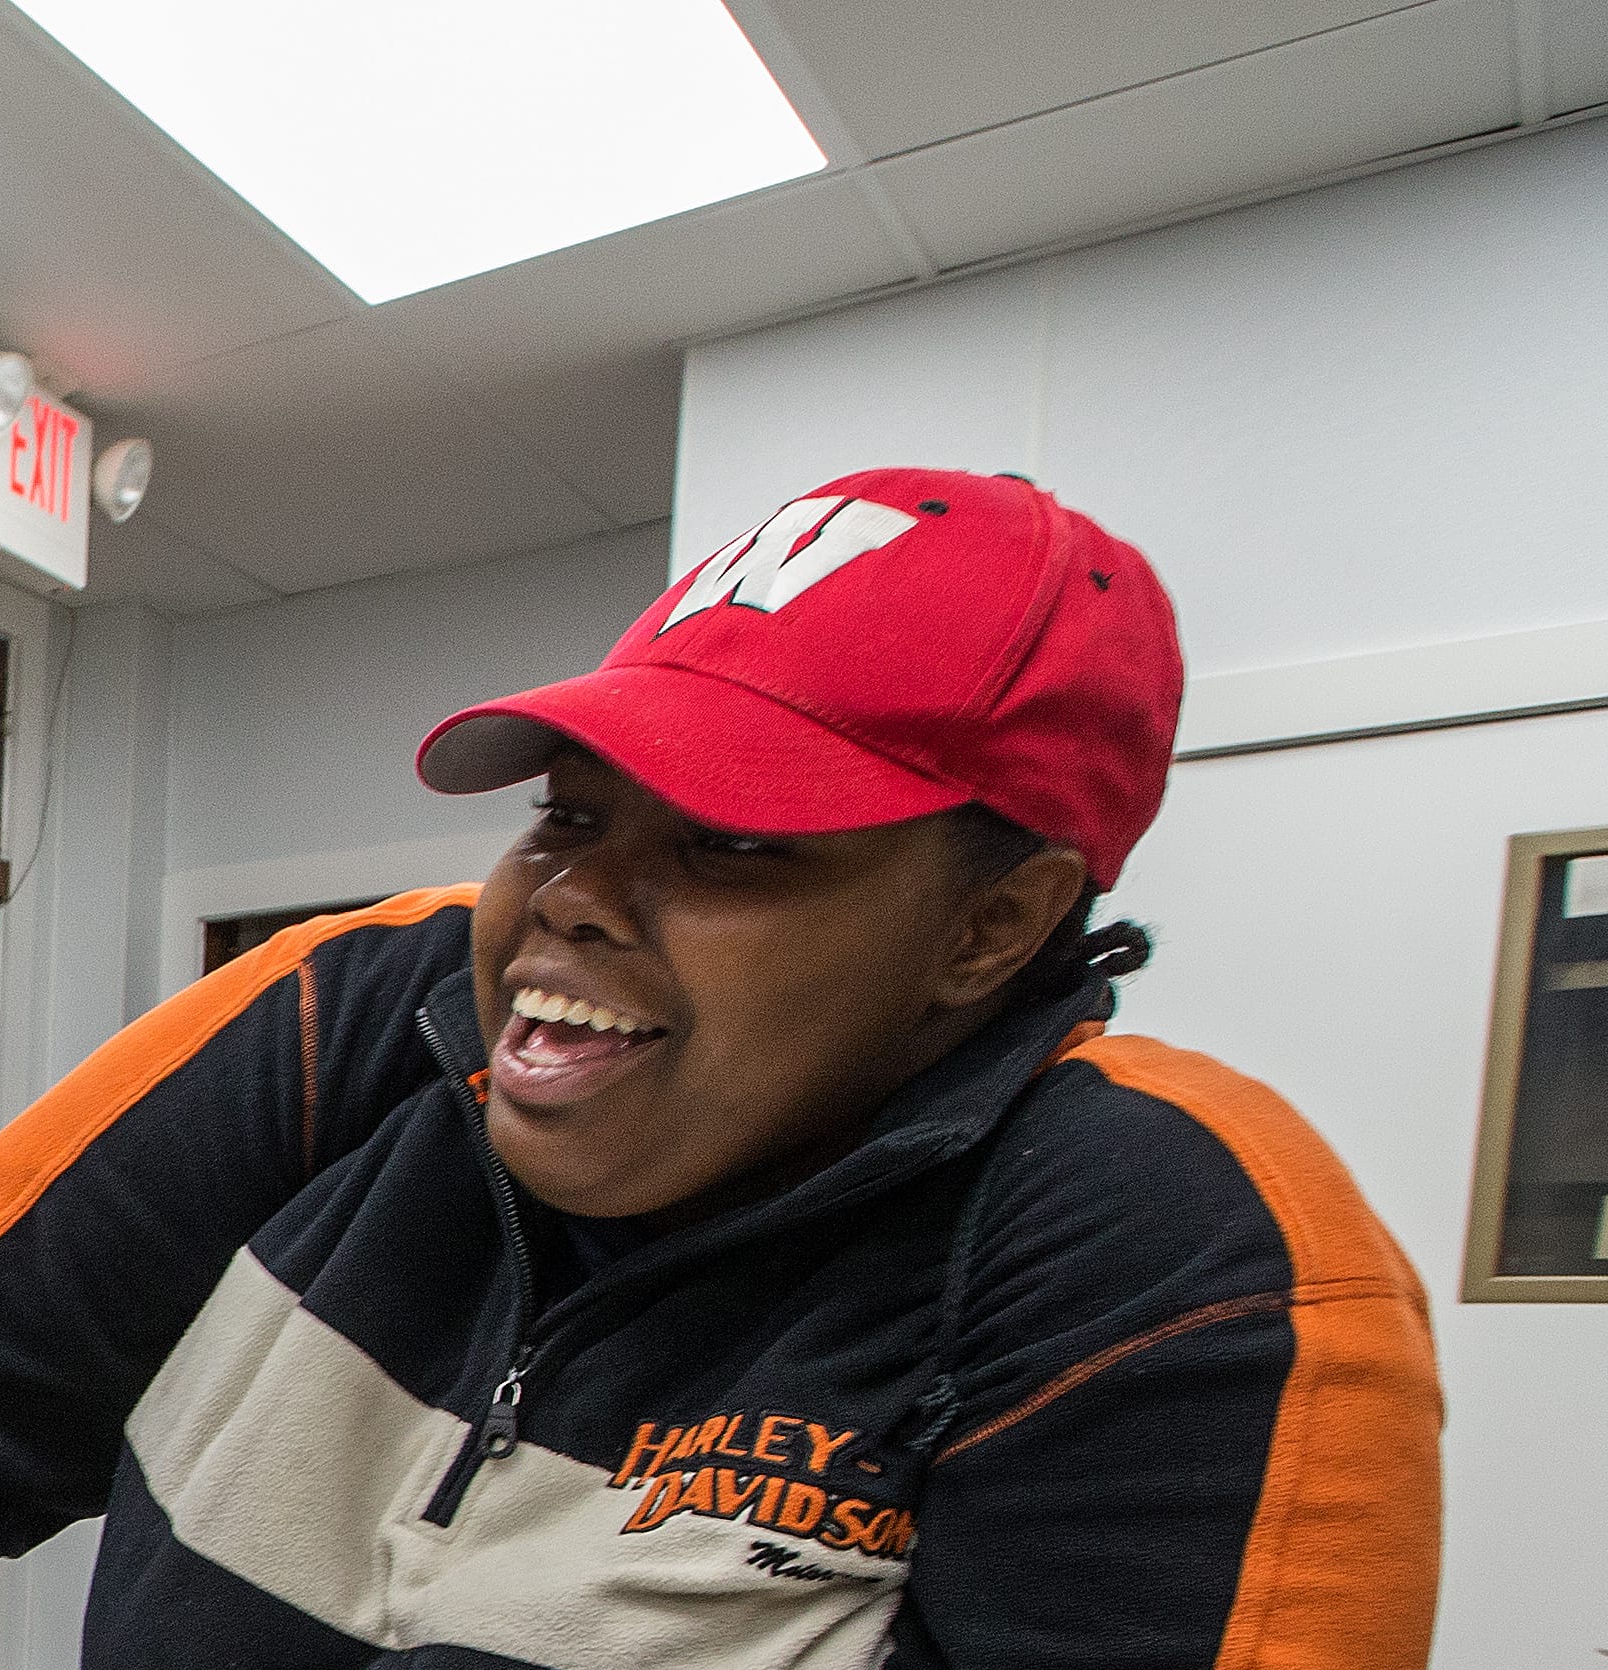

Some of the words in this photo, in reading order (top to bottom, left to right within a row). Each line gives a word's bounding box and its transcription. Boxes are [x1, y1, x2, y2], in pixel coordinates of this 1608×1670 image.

[9, 396, 81, 523] EXIT
[651, 494, 920, 644] W
[620, 1467, 919, 1559] DAVIDSON
